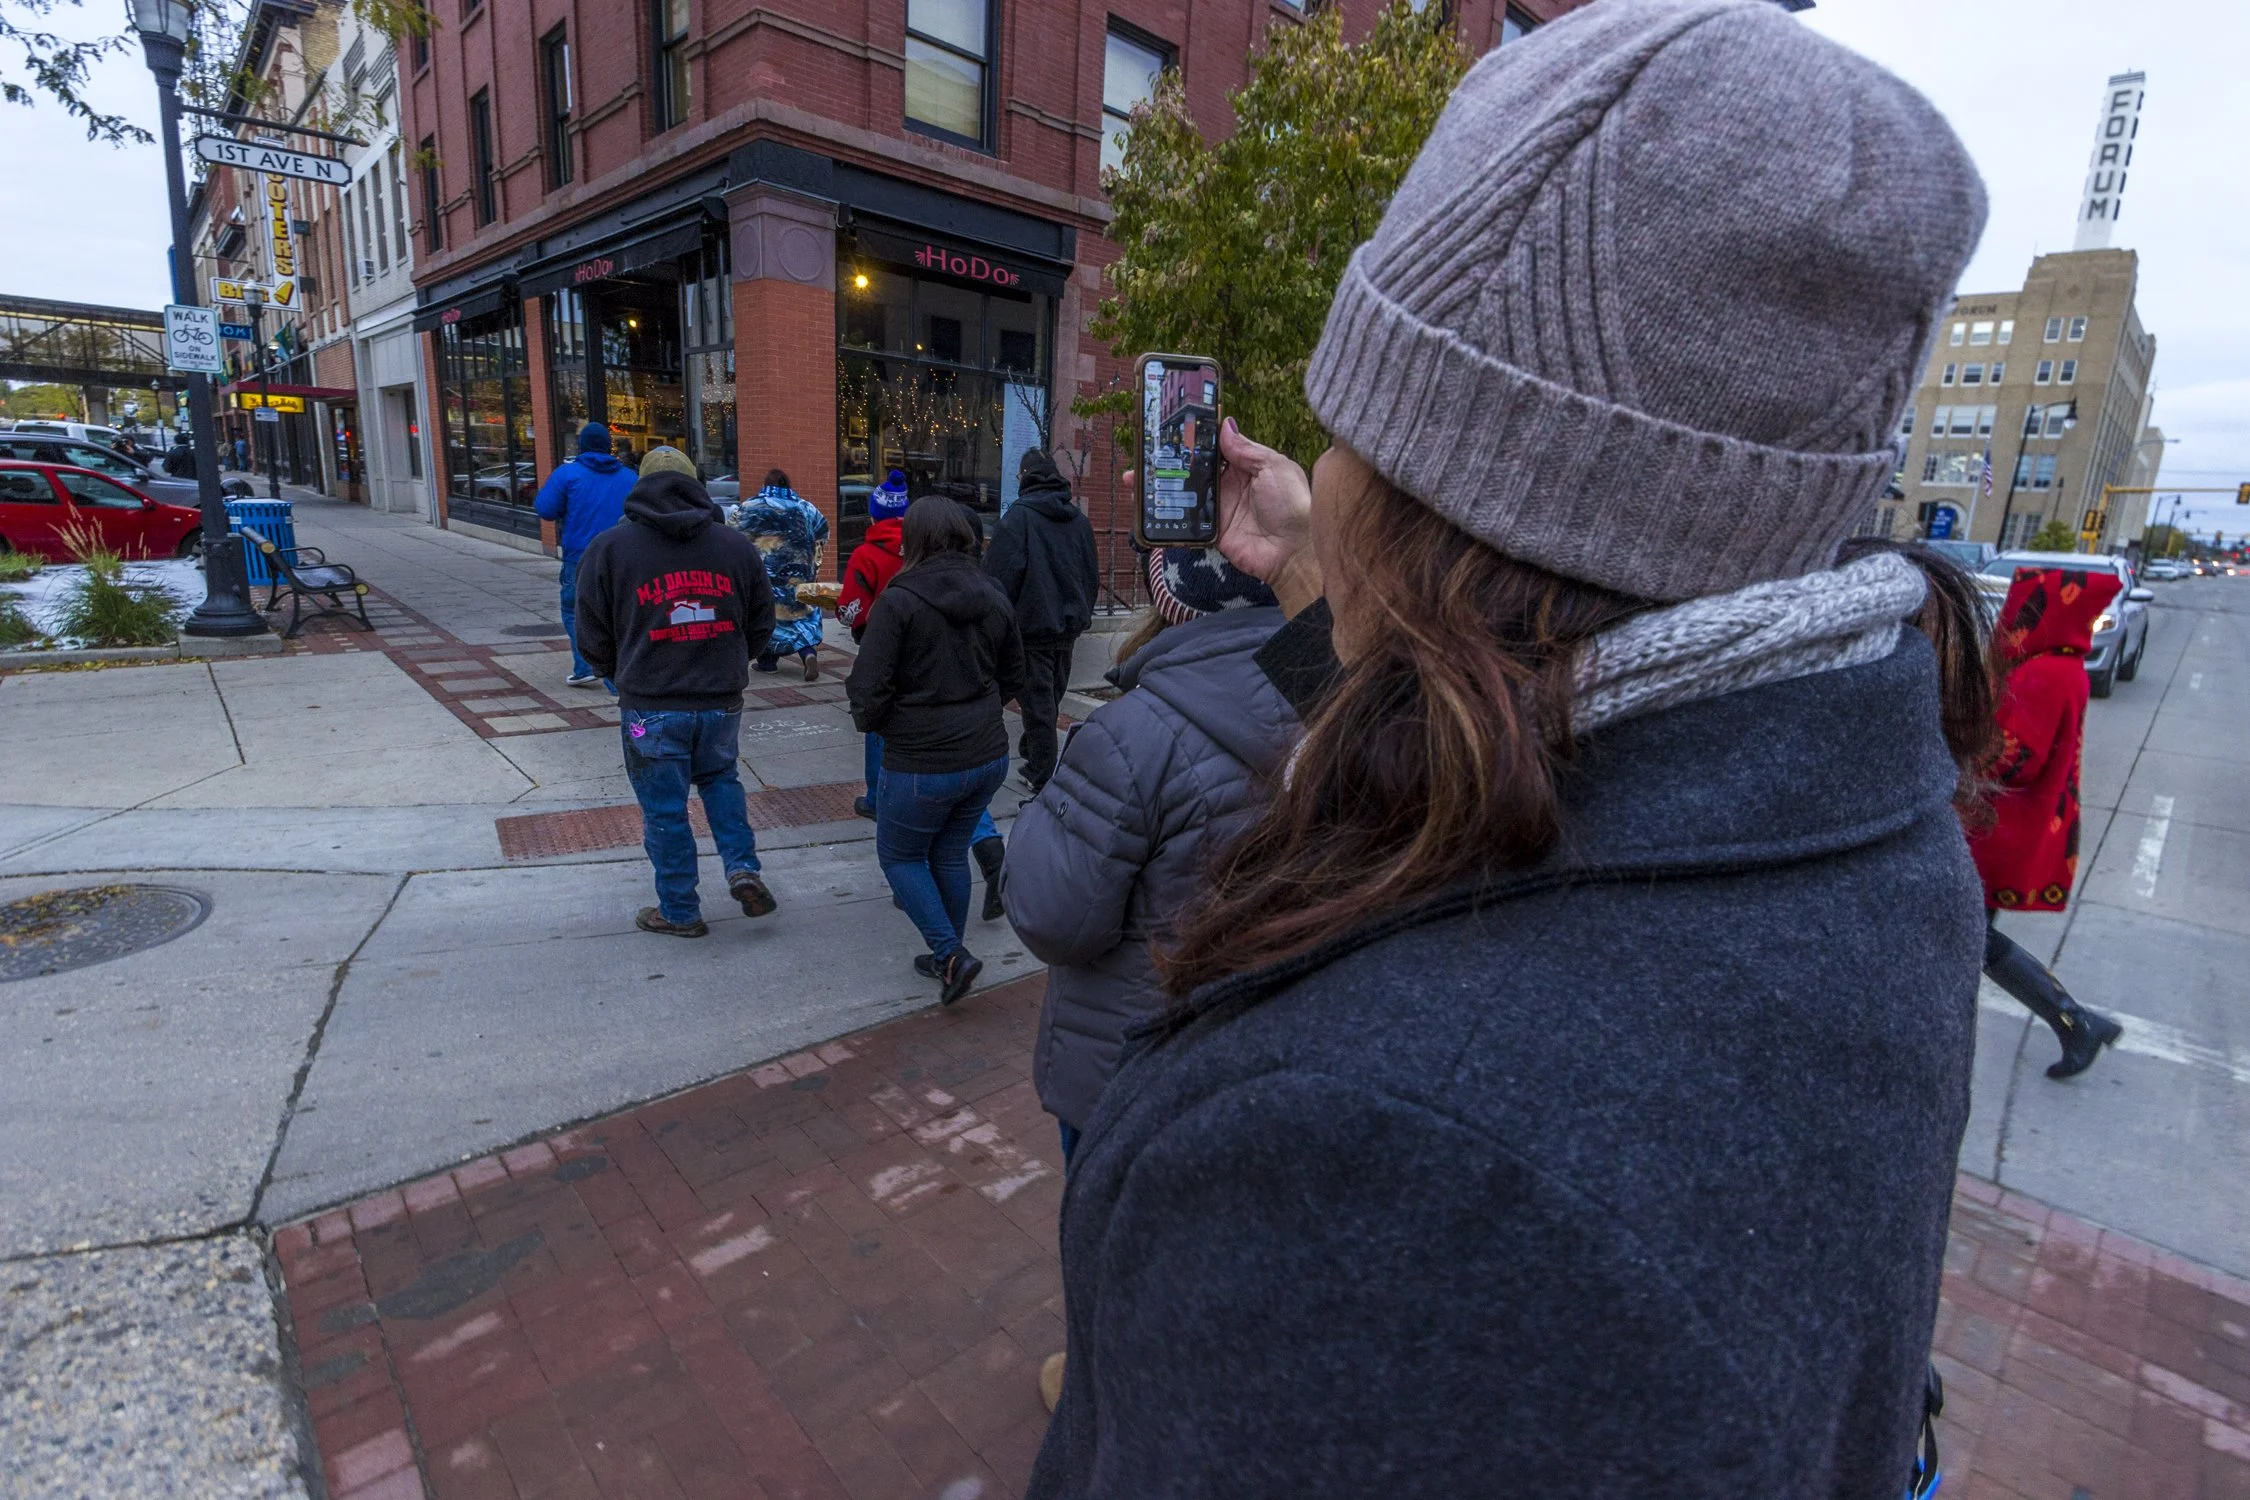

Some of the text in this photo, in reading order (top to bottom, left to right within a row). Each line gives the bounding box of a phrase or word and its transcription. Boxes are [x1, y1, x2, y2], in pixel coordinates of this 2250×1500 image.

[216, 143, 332, 179] 1ST AVE N
[2087, 89, 2133, 221] FORUM
[926, 245, 1009, 285] HoDo
[173, 311, 208, 324] WALK
[174, 351, 216, 361] SIDEWALK
[188, 345, 201, 353] ON
[636, 577, 664, 606] M.J.
[664, 570, 713, 591] DALSIN
